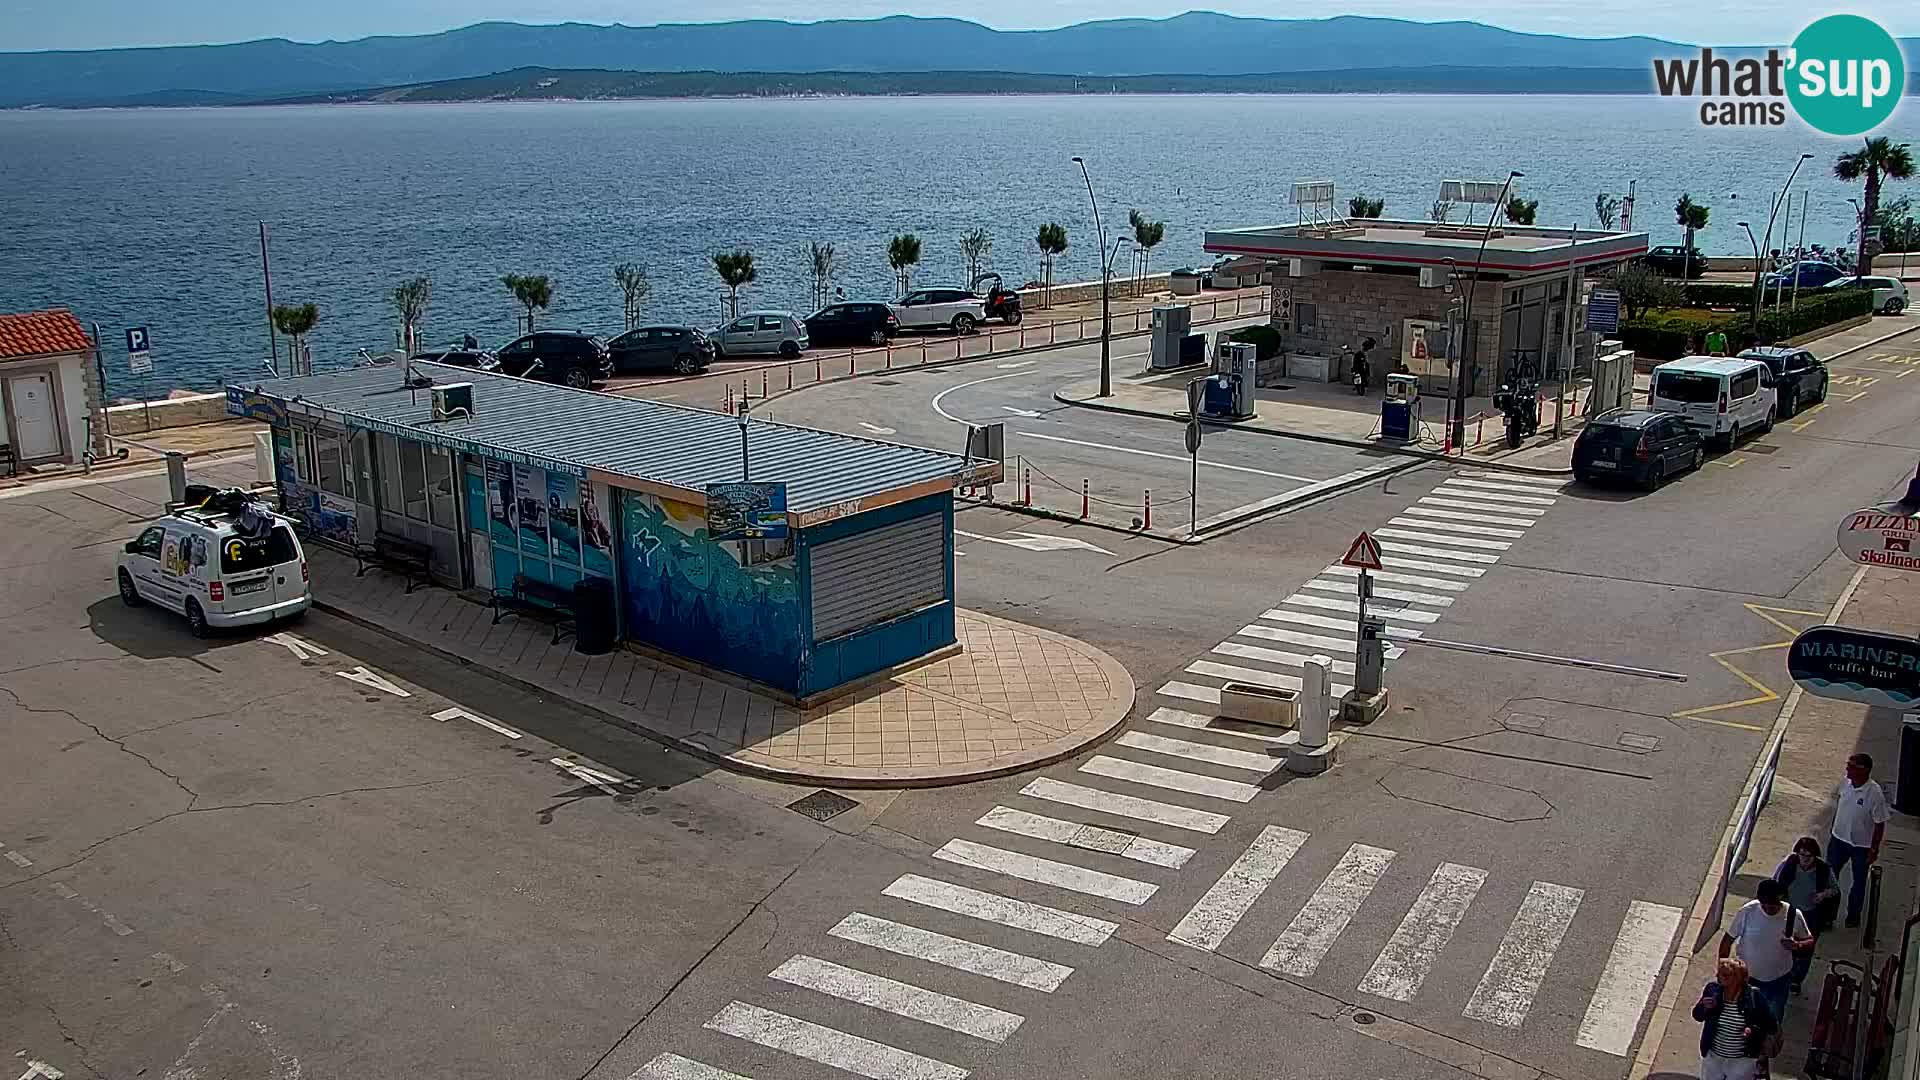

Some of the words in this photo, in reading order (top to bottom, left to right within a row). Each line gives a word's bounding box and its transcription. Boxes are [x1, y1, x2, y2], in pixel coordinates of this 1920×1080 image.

[131, 330, 143, 348] P
[437, 436, 468, 450] POSTAJA
[480, 445, 493, 456] BUS
[495, 449, 527, 464] STATION
[528, 456, 554, 470] TICKET
[556, 463, 583, 476] OFFICE
[1848, 515, 1920, 532] PIZZE
[1881, 530, 1916, 540] GRILL
[1870, 665, 1897, 679] bar
